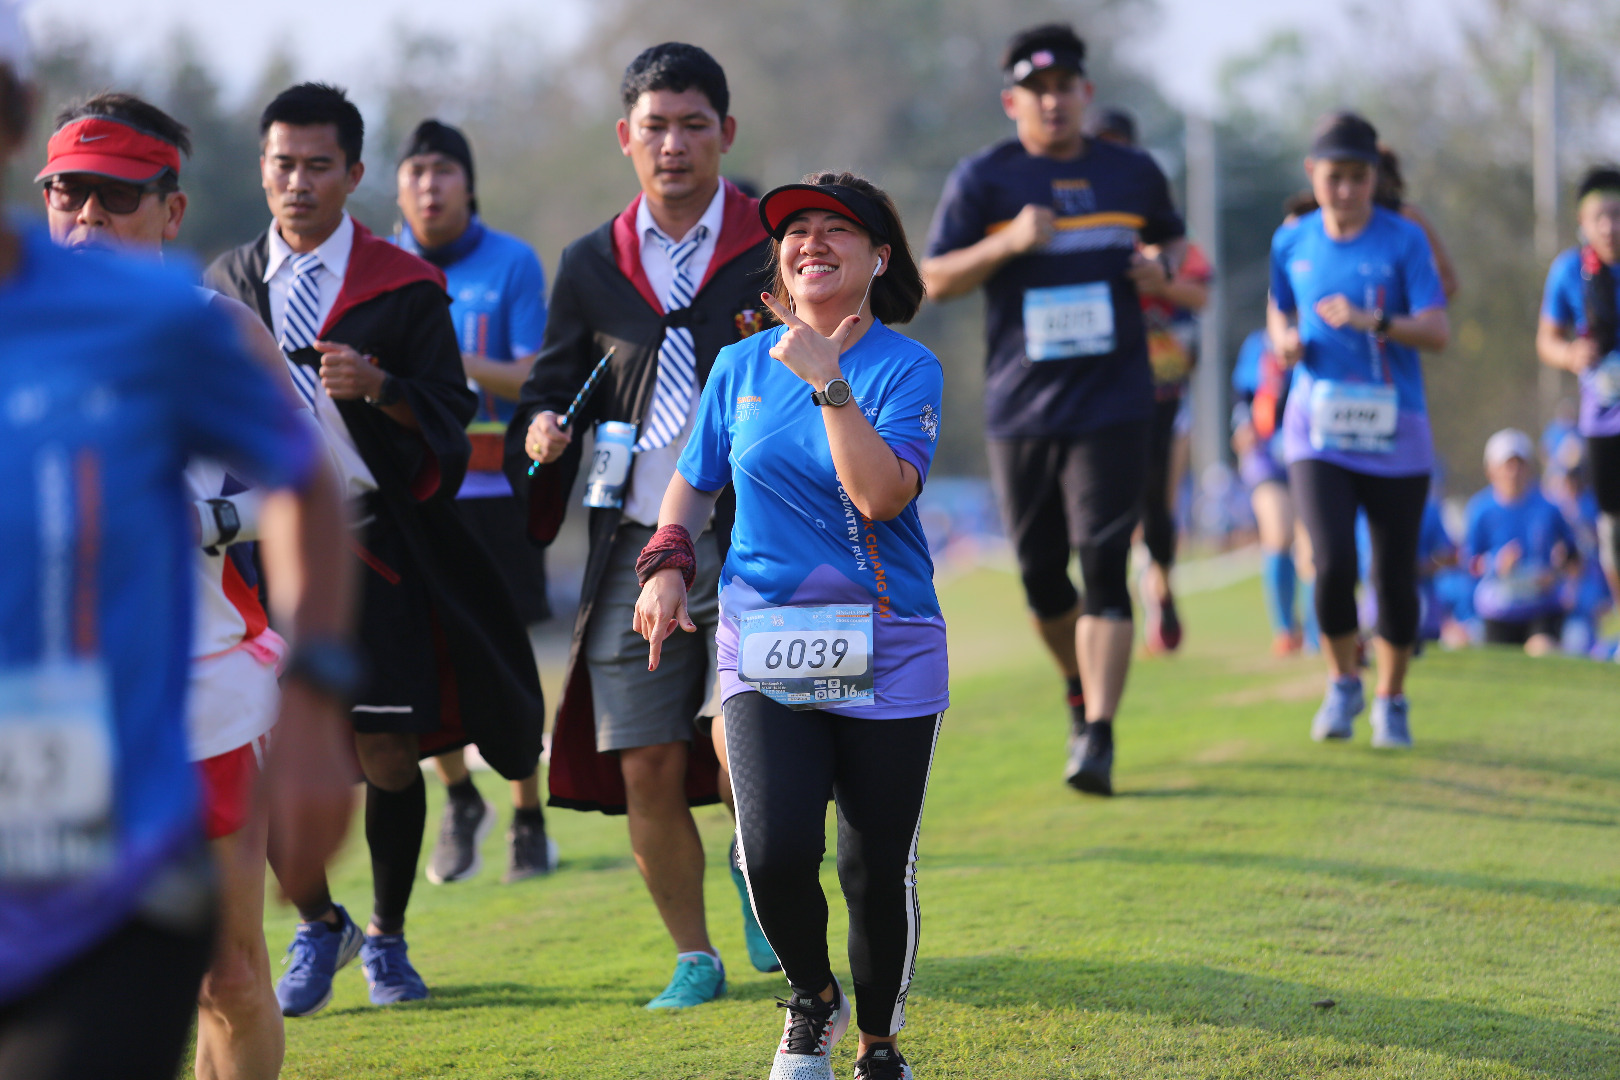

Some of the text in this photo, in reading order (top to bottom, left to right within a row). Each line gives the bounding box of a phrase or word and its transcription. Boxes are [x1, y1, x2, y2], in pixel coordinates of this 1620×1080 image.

[736, 396, 762, 404] SINGHA
[864, 407, 878, 417] XC
[851, 545, 868, 571] RUN
[865, 533, 887, 592] CHIANG
[878, 596, 892, 619] RAI
[765, 638, 849, 670] 6039
